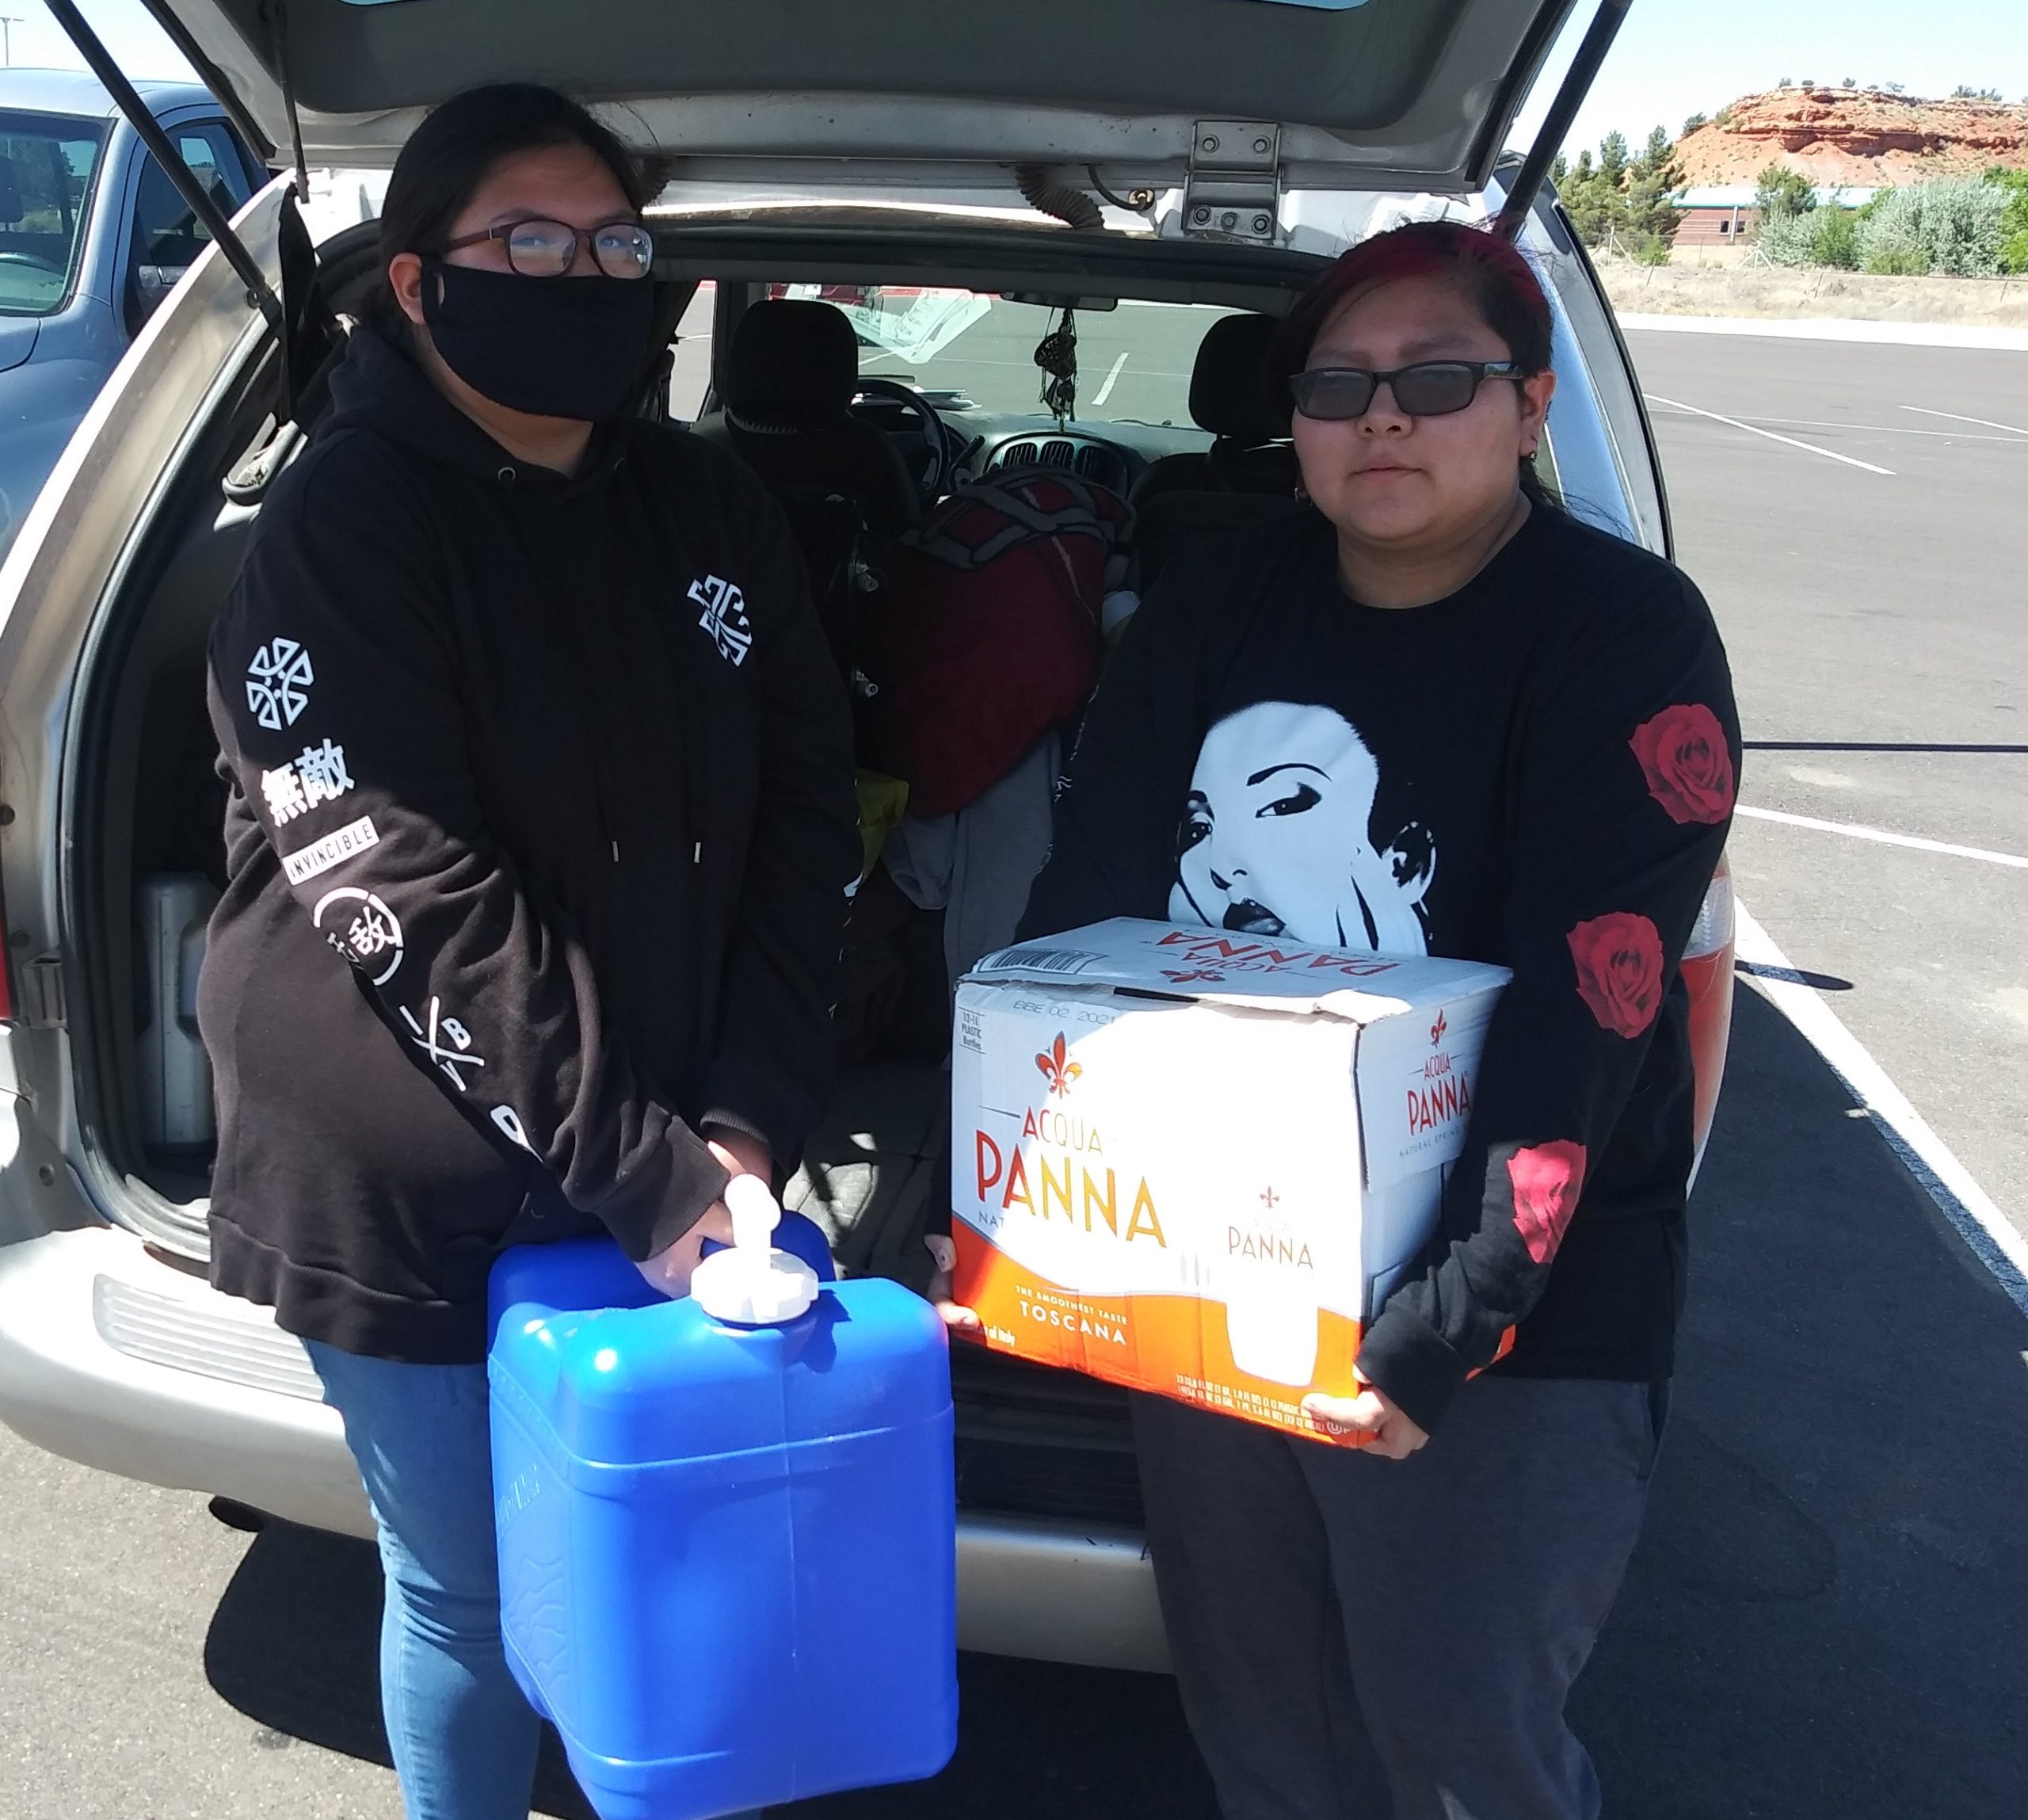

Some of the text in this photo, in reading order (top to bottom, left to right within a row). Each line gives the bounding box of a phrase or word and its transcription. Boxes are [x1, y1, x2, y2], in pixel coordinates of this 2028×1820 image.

[261, 738, 355, 827] 無敵
[290, 824, 372, 878] INVINCIBLE
[1157, 931, 1401, 976] PANNA
[1181, 952, 1292, 973] ACQUA
[1013, 1000, 1045, 1013] BBE
[1077, 1010, 1115, 1024] 2021
[1424, 1052, 1451, 1080] ACQUA
[1407, 1072, 1471, 1136] PANNA
[1023, 1105, 1104, 1156] ACQUA
[976, 1128, 1167, 1249] PANNA
[1229, 1226, 1313, 1269] PANNA
[1016, 1285, 1128, 1326] THE SMOOTHEST TASTE
[1020, 1299, 1126, 1346] TOSCANA
